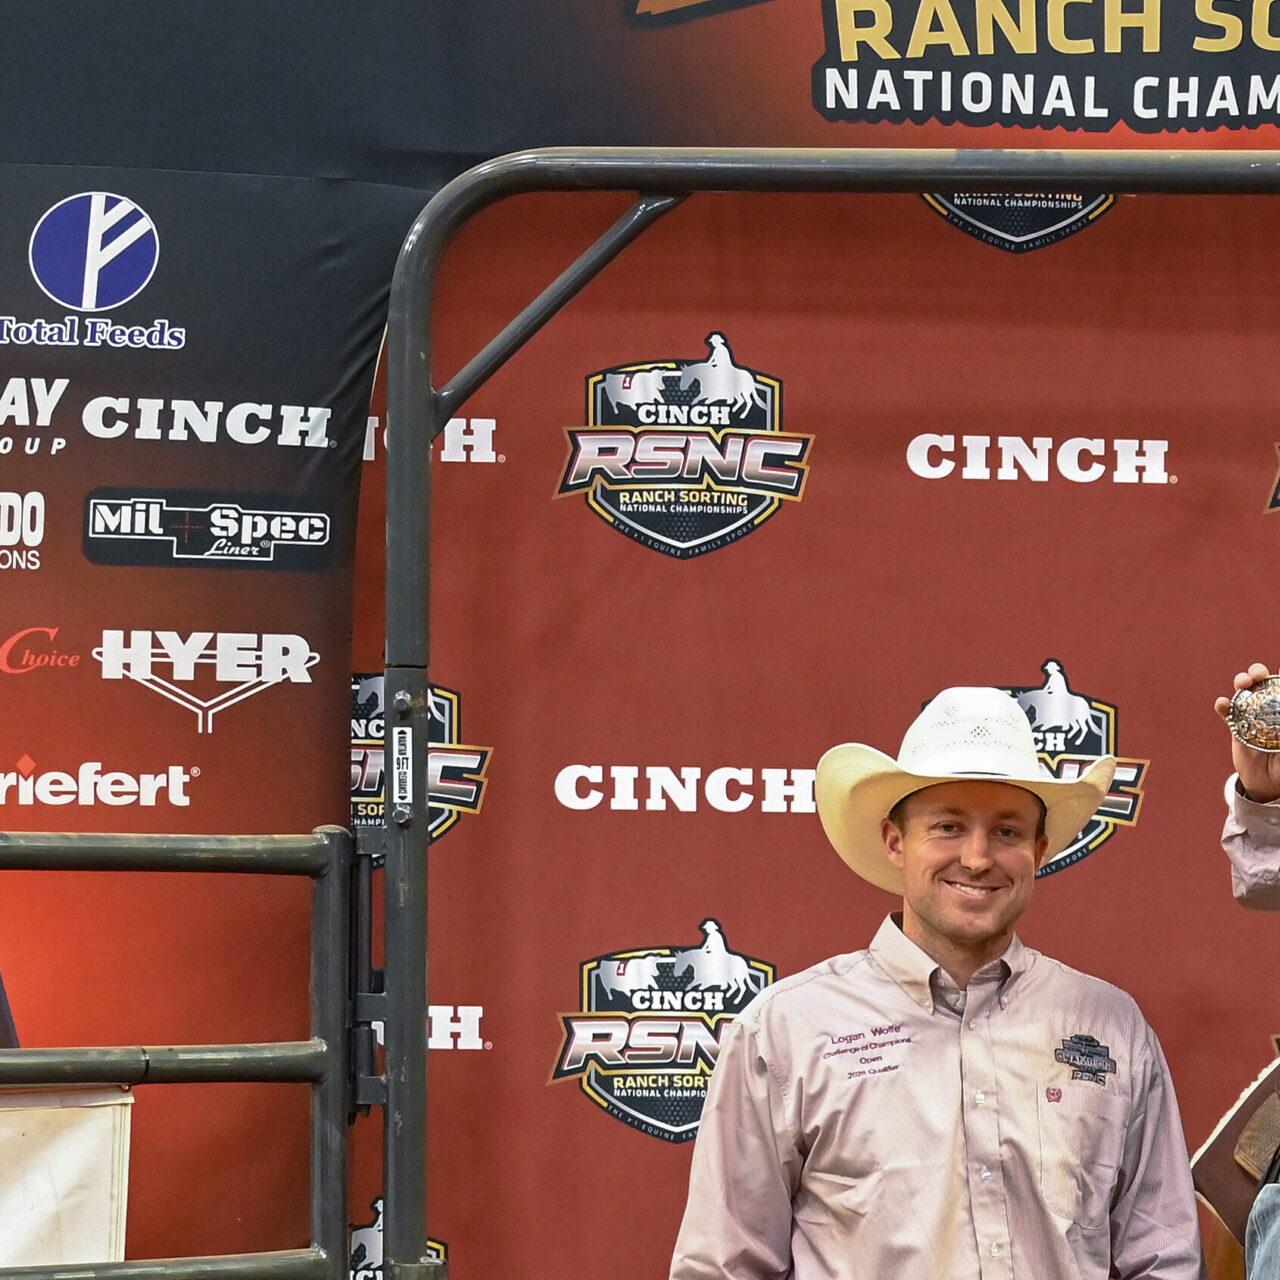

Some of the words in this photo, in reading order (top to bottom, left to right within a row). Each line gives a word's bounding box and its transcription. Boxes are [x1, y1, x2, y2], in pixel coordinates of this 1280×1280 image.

[835, 0, 1161, 63] RANCH
[824, 67, 1110, 119] NATIONAL
[953, 197, 1002, 207] NATIONAL
[1004, 198, 1084, 210] CHAMPIONSHIPS
[0, 316, 78, 345] Total
[84, 318, 186, 350] Feeds
[82, 395, 332, 448] CINCH
[638, 404, 730, 425] CINCH
[0, 436, 67, 456] OUP
[905, 432, 1170, 485] CINCH
[568, 434, 803, 490] RSNC
[619, 490, 676, 505] RANCH
[679, 491, 748, 506] SORTING
[619, 503, 667, 513] NATIONAL
[670, 504, 748, 515] CHAMPIONSHIPS
[94, 502, 164, 535] Mil
[210, 508, 326, 545] Spec
[204, 538, 259, 557] Liner
[0, 627, 81, 674] Choice
[102, 629, 314, 683] HYER
[0, 755, 191, 806] riefert
[553, 763, 817, 814] CINCH
[632, 990, 725, 1011] CINCH
[563, 1020, 735, 1071] RSN
[823, 1045, 861, 1060] Challenge
[868, 1037, 912, 1050] Champions
[831, 1032, 866, 1045] Logan
[870, 1024, 901, 1037] Wolfe
[859, 1055, 883, 1064] Open
[613, 1075, 670, 1089] RANCH
[613, 1088, 661, 1097] NATIONAL
[663, 1089, 707, 1098] CHAMPIO
